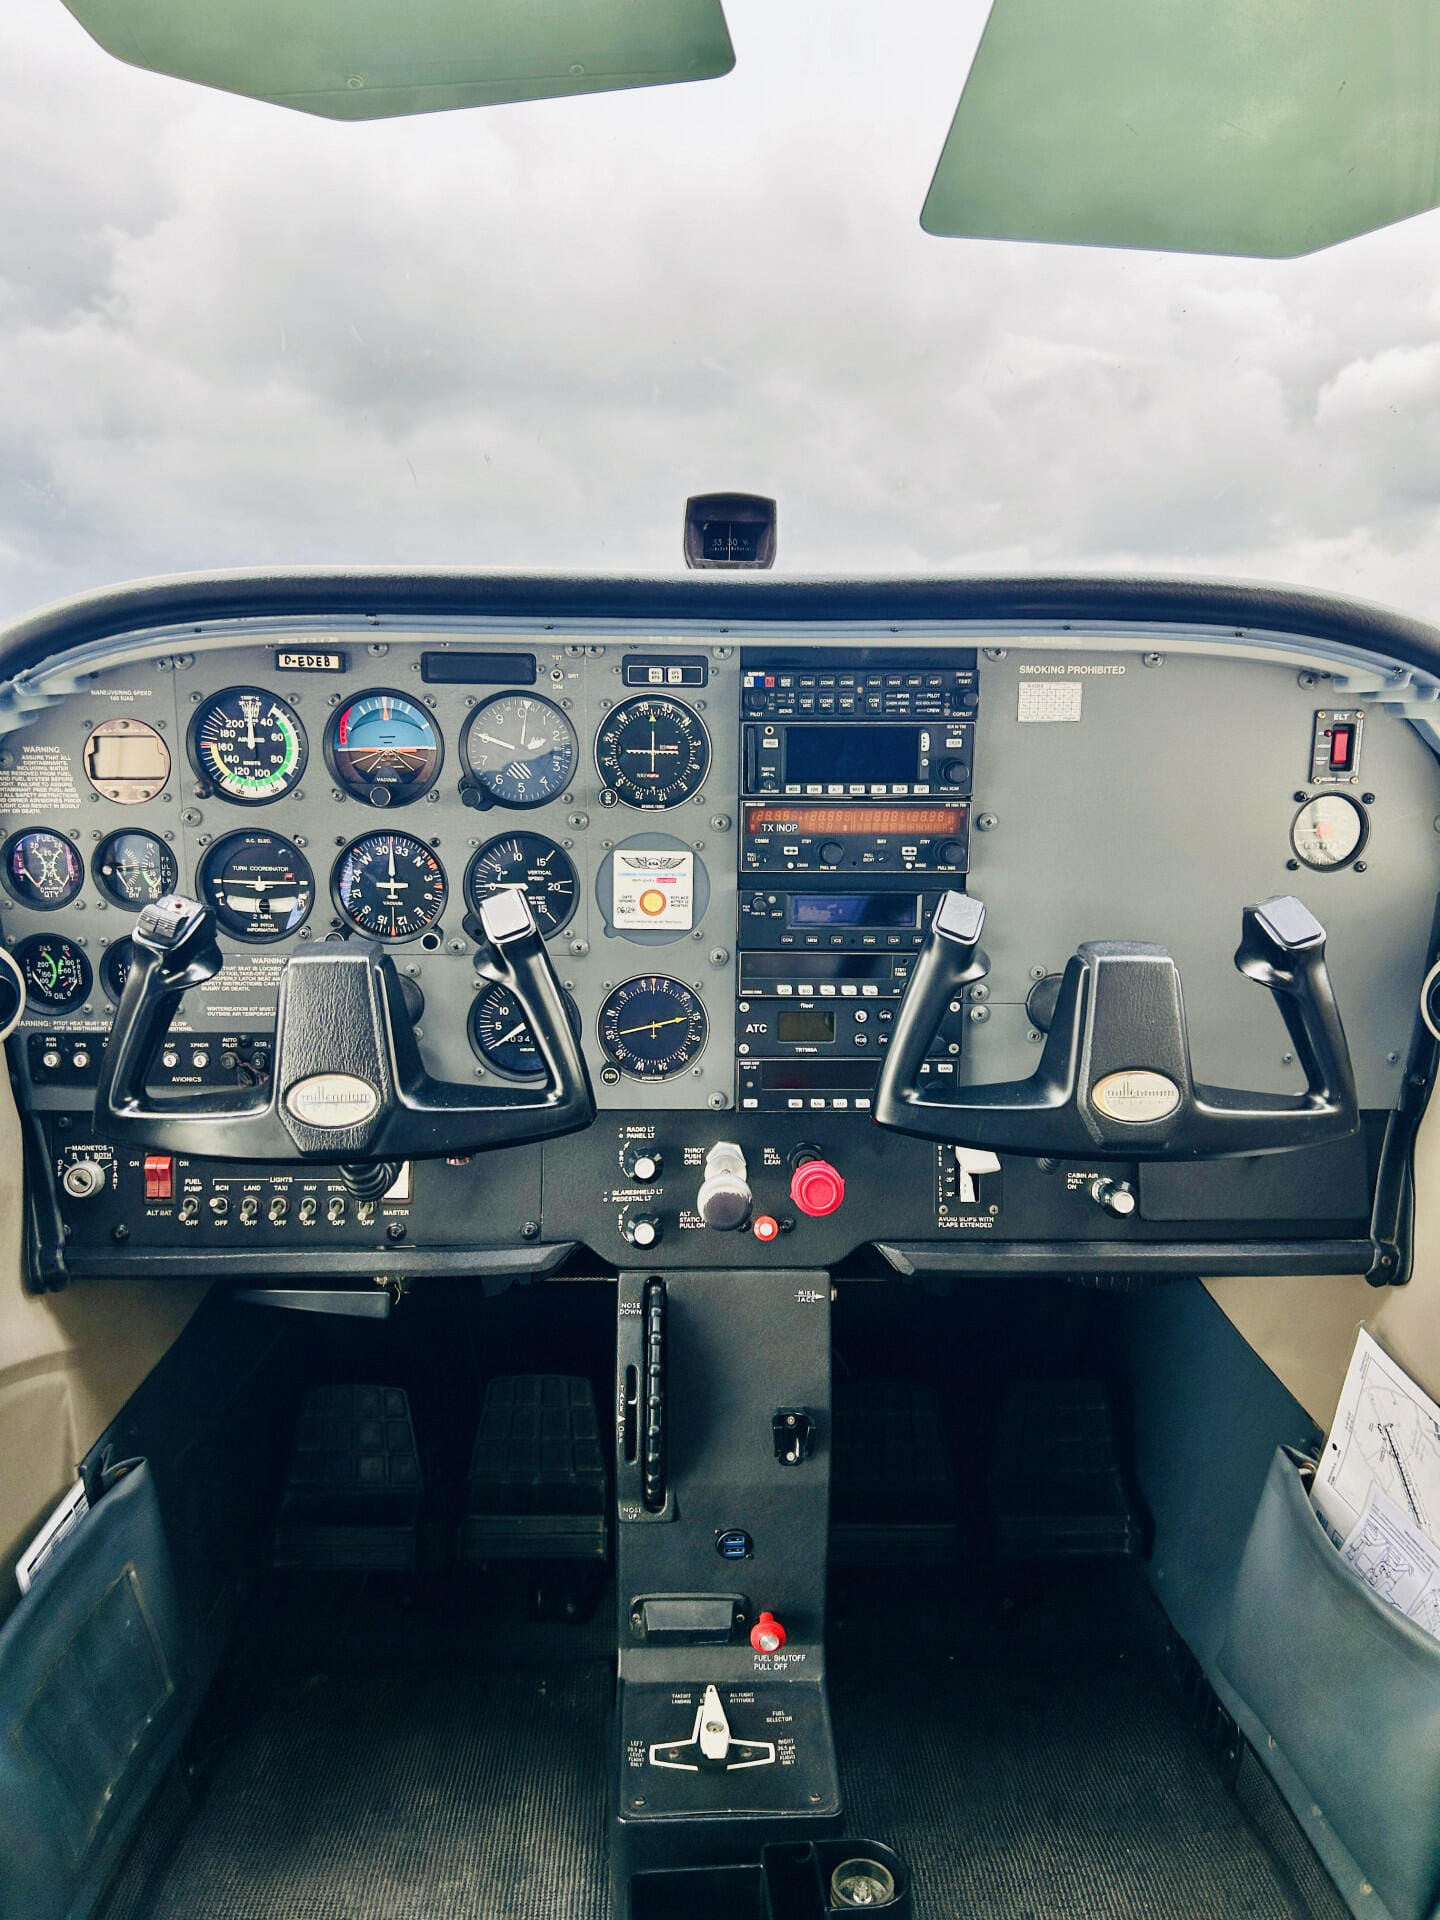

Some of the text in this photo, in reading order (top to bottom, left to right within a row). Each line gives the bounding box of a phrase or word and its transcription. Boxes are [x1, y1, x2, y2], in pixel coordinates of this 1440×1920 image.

[284, 655, 330, 667] D-EDEB
[1019, 665, 1126, 675] SMOKING PROHIBITED
[638, 702, 649, 711] 30
[661, 702, 673, 713] 33
[1333, 713, 1349, 721] ELT
[225, 719, 245, 729] 200
[260, 718, 274, 727] 40
[220, 729, 236, 738] 180
[23, 745, 61, 753] WARNING
[218, 743, 234, 751] 160
[224, 755, 240, 764] 140
[234, 767, 271, 777] 120 100
[761, 823, 798, 833] TX INOP
[375, 846, 389, 856] 30
[395, 846, 409, 857] 33
[513, 853, 522, 861] 10
[536, 858, 546, 866] 15
[547, 882, 561, 891] 20
[538, 904, 548, 913] 15
[500, 1006, 509, 1016] 10
[692, 1011, 701, 1021] 15
[745, 1023, 768, 1033] ATC
[605, 1030, 615, 1041] 33
[774, 1654, 806, 1662] SHUTOFF
[753, 1663, 788, 1671] PULL OFF
